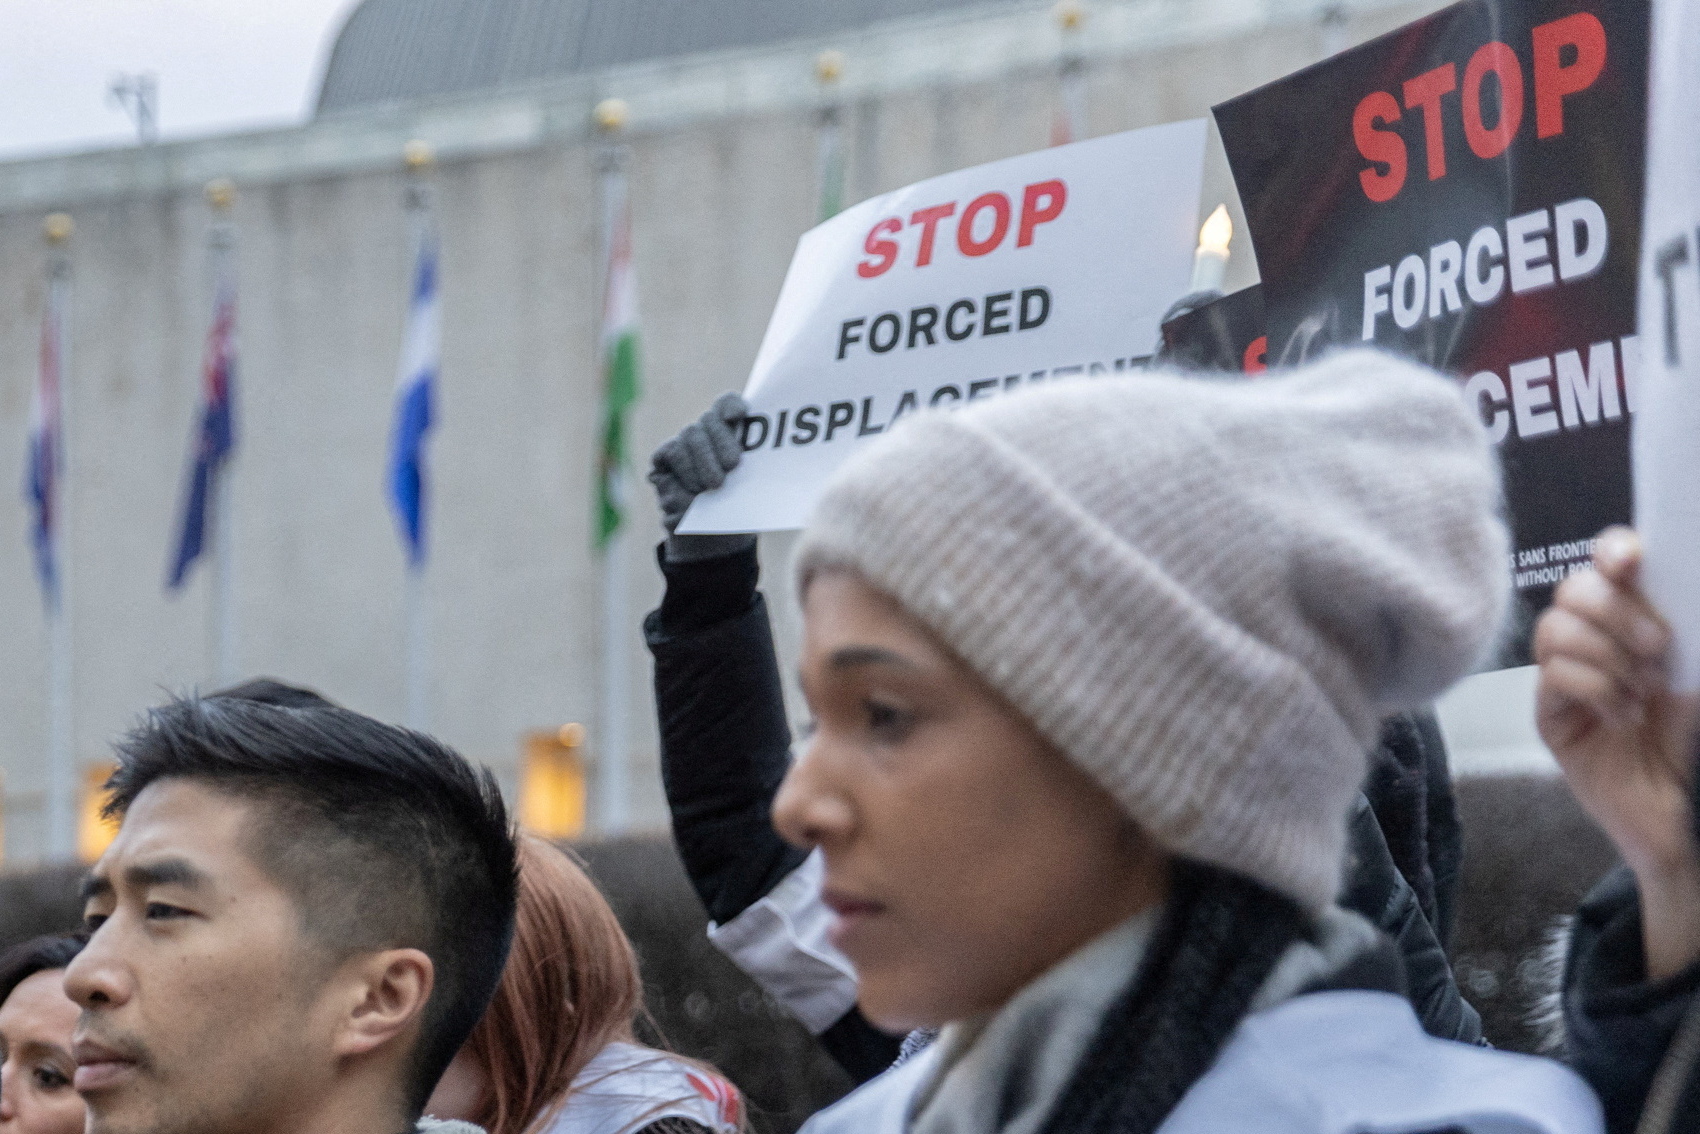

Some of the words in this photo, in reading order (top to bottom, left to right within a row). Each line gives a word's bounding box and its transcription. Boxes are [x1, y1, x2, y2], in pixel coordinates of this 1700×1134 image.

[1352, 11, 1608, 203] STOP
[856, 178, 1068, 279] STOP
[1362, 198, 1608, 340] FORCED
[836, 285, 1053, 360] FORCED
